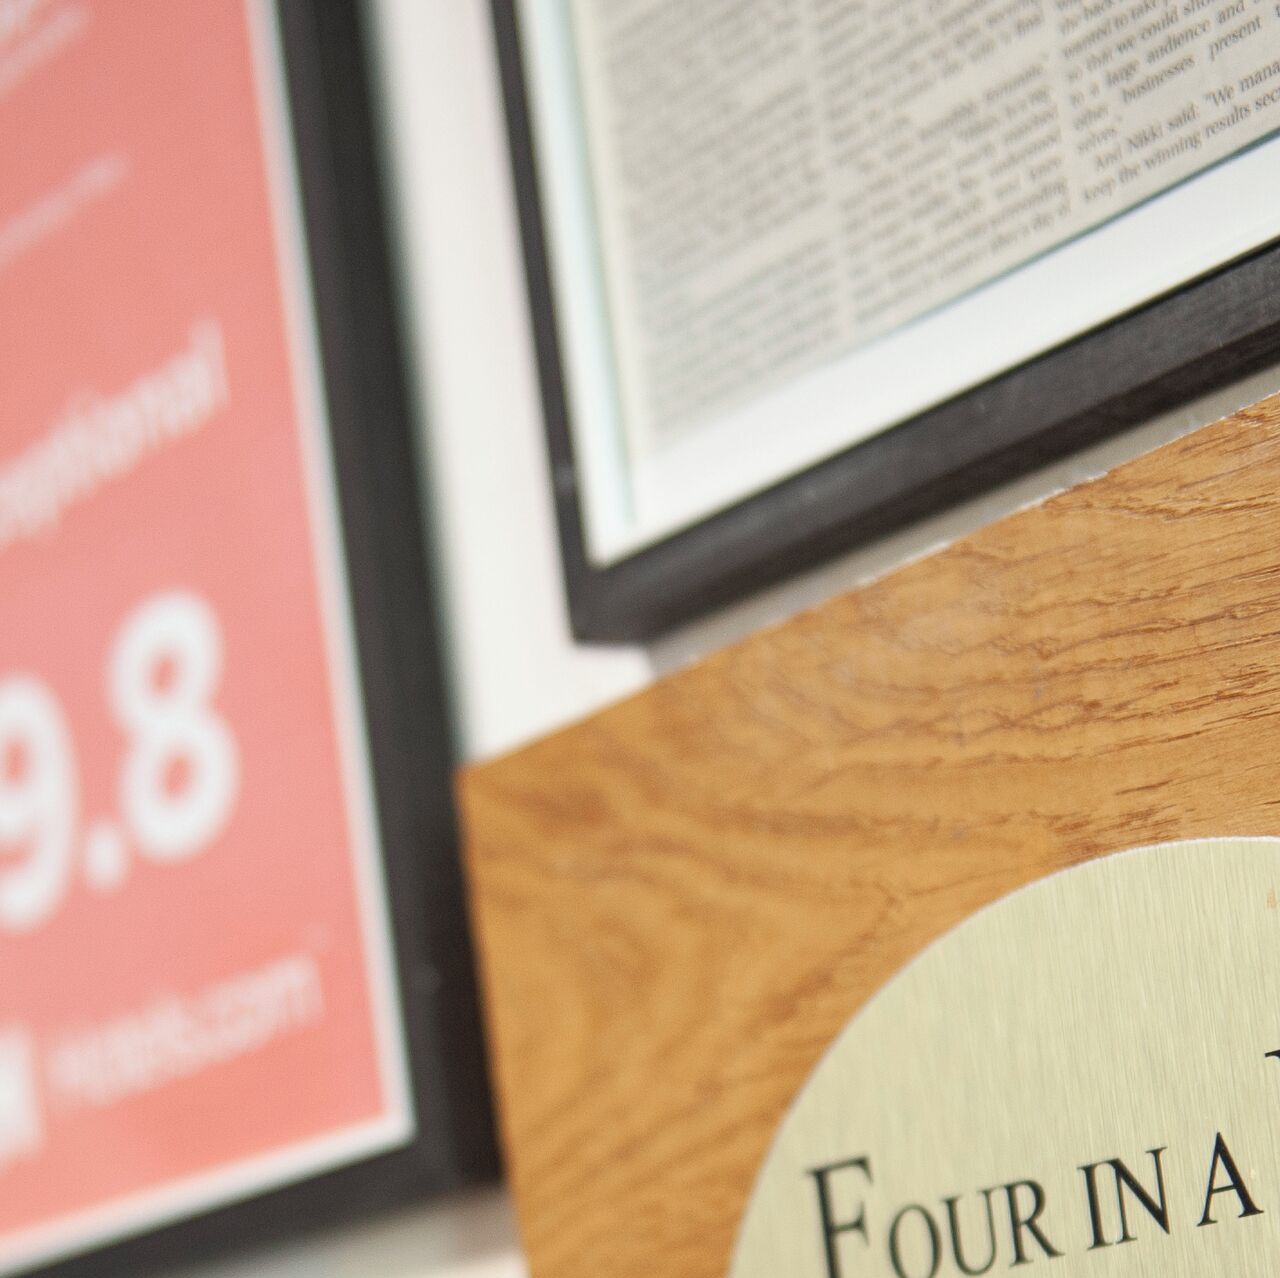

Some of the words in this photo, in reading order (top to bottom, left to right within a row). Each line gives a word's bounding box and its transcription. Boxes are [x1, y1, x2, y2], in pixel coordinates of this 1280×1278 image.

[1139, 4, 1179, 40] could
[1146, 18, 1211, 64] audience
[1217, 0, 1246, 25] and
[1122, 52, 1196, 104] businesses
[1208, 15, 1262, 62] present
[1126, 119, 1163, 153] Nikki
[1143, 130, 1202, 170] winning
[1205, 104, 1253, 139] results
[1077, 1146, 1172, 1252] IN
[1196, 1131, 1265, 1228] A
